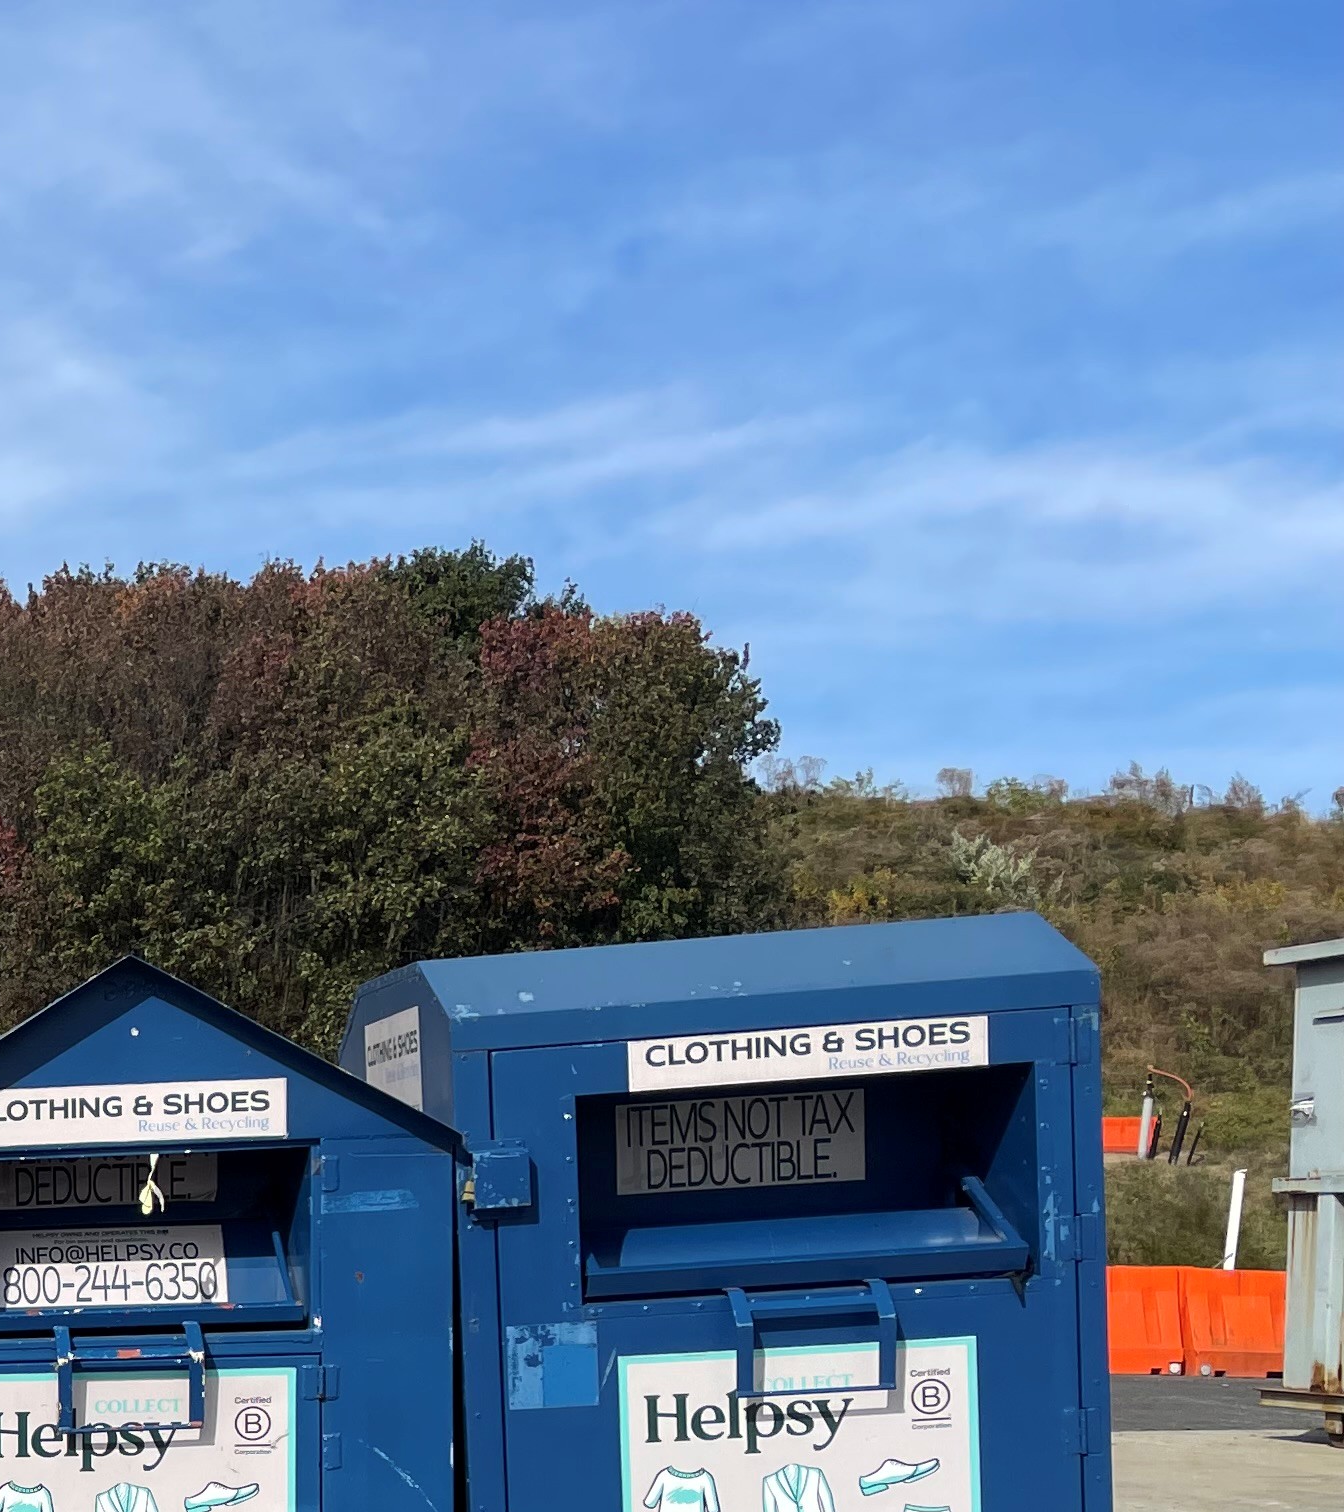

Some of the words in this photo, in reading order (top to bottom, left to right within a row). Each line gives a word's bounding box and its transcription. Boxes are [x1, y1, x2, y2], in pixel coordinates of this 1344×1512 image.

[645, 1033, 811, 1067] CLOTHING
[822, 1031, 845, 1053] &
[855, 1022, 971, 1051] SHOES
[829, 1054, 874, 1070] Reuse
[879, 1052, 893, 1067] &
[897, 1049, 971, 1067] Recycling
[133, 1095, 153, 1116] &
[163, 1090, 270, 1116] SHOES
[139, 1118, 180, 1132] Reuse
[185, 1117, 198, 1131] &
[201, 1116, 269, 1132] Recycling
[626, 1101, 717, 1148] ITEMS
[723, 1097, 791, 1141] NOT
[792, 1091, 856, 1137] TAX
[647, 1138, 838, 1190] DEDUCTIBLE.
[15, 1242, 199, 1265] INFO@HELPSY.CO
[3, 1261, 217, 1304] 800-244-6350
[758, 1373, 854, 1389] COLLECT
[910, 1367, 951, 1377] Certified
[95, 1397, 183, 1414] COLLECT
[235, 1396, 272, 1404] Certified
[921, 1386, 941, 1408] B
[244, 1414, 262, 1433] B
[644, 1389, 854, 1454] Helpsy
